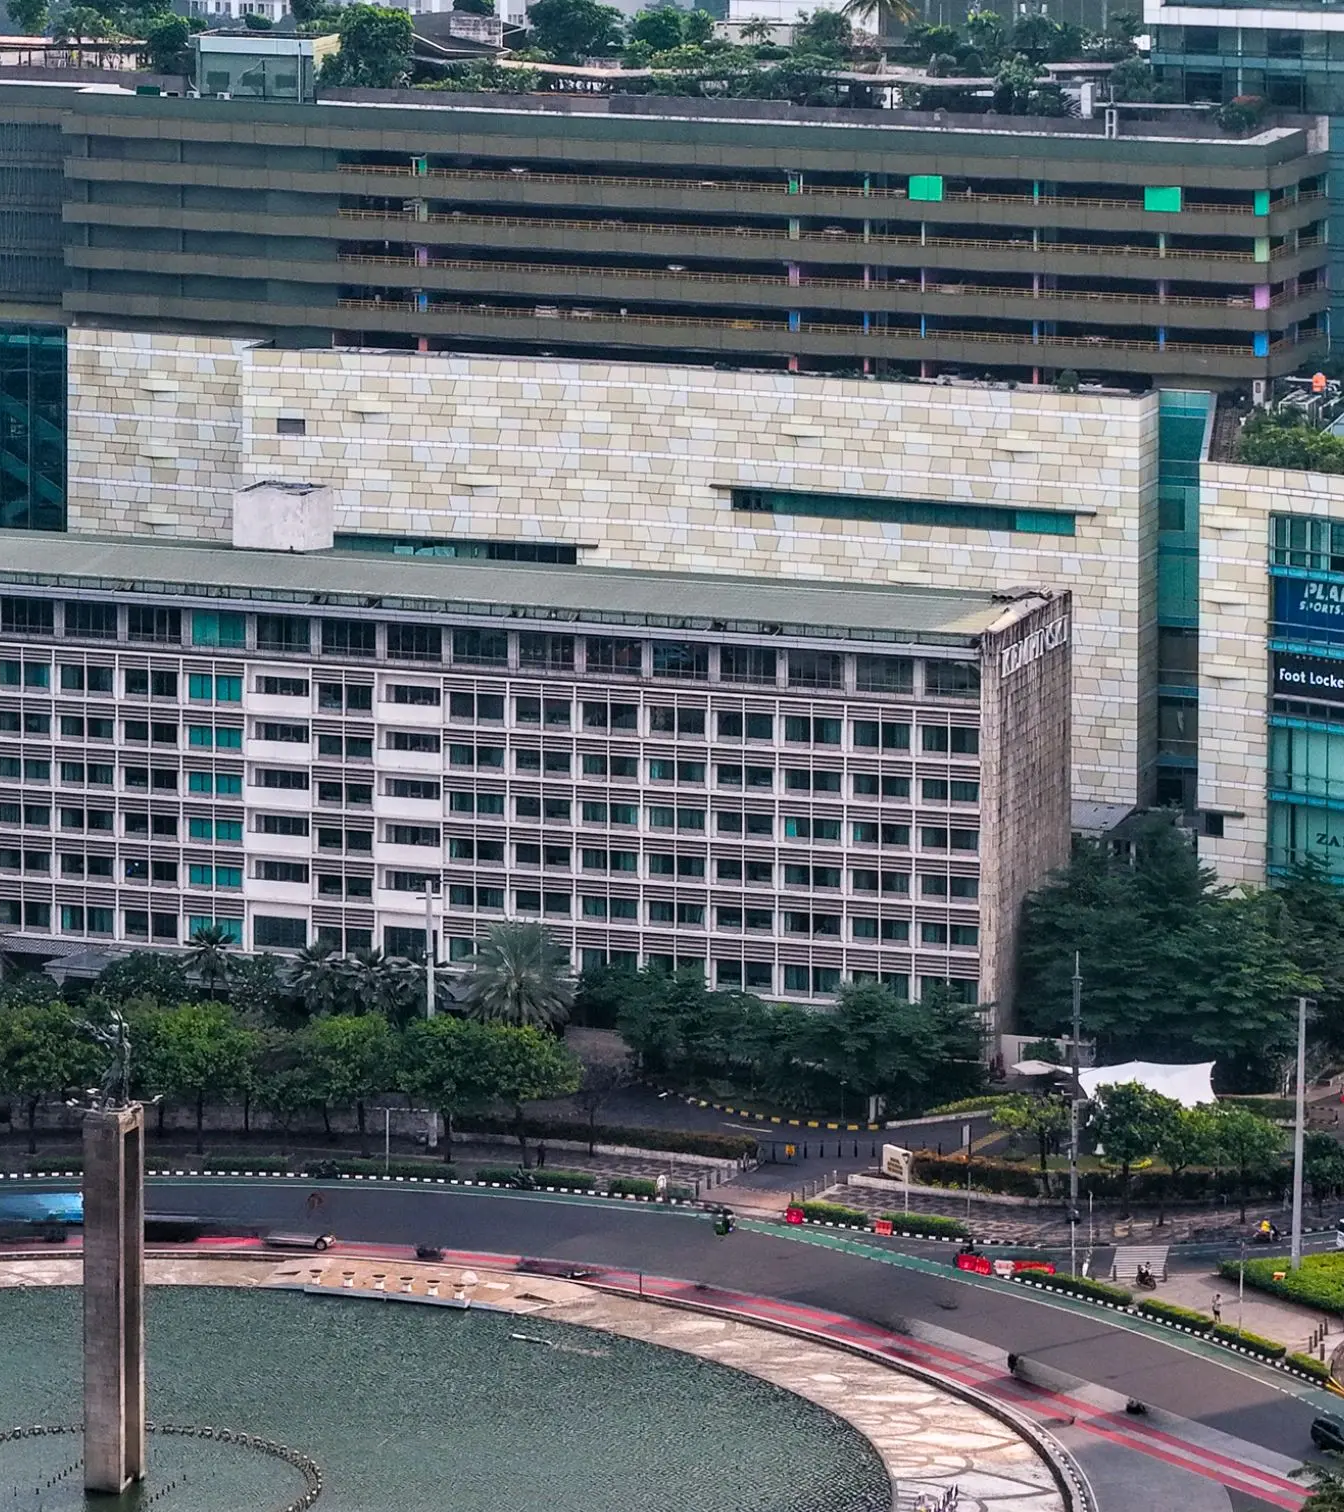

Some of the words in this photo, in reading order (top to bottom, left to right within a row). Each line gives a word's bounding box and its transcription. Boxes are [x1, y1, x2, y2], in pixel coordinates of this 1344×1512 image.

[1001, 614, 1068, 678] KEMPINSKI
[1279, 667, 1306, 683] Foot
[1309, 671, 1344, 688] Locke
[1316, 833, 1344, 848] ZA
